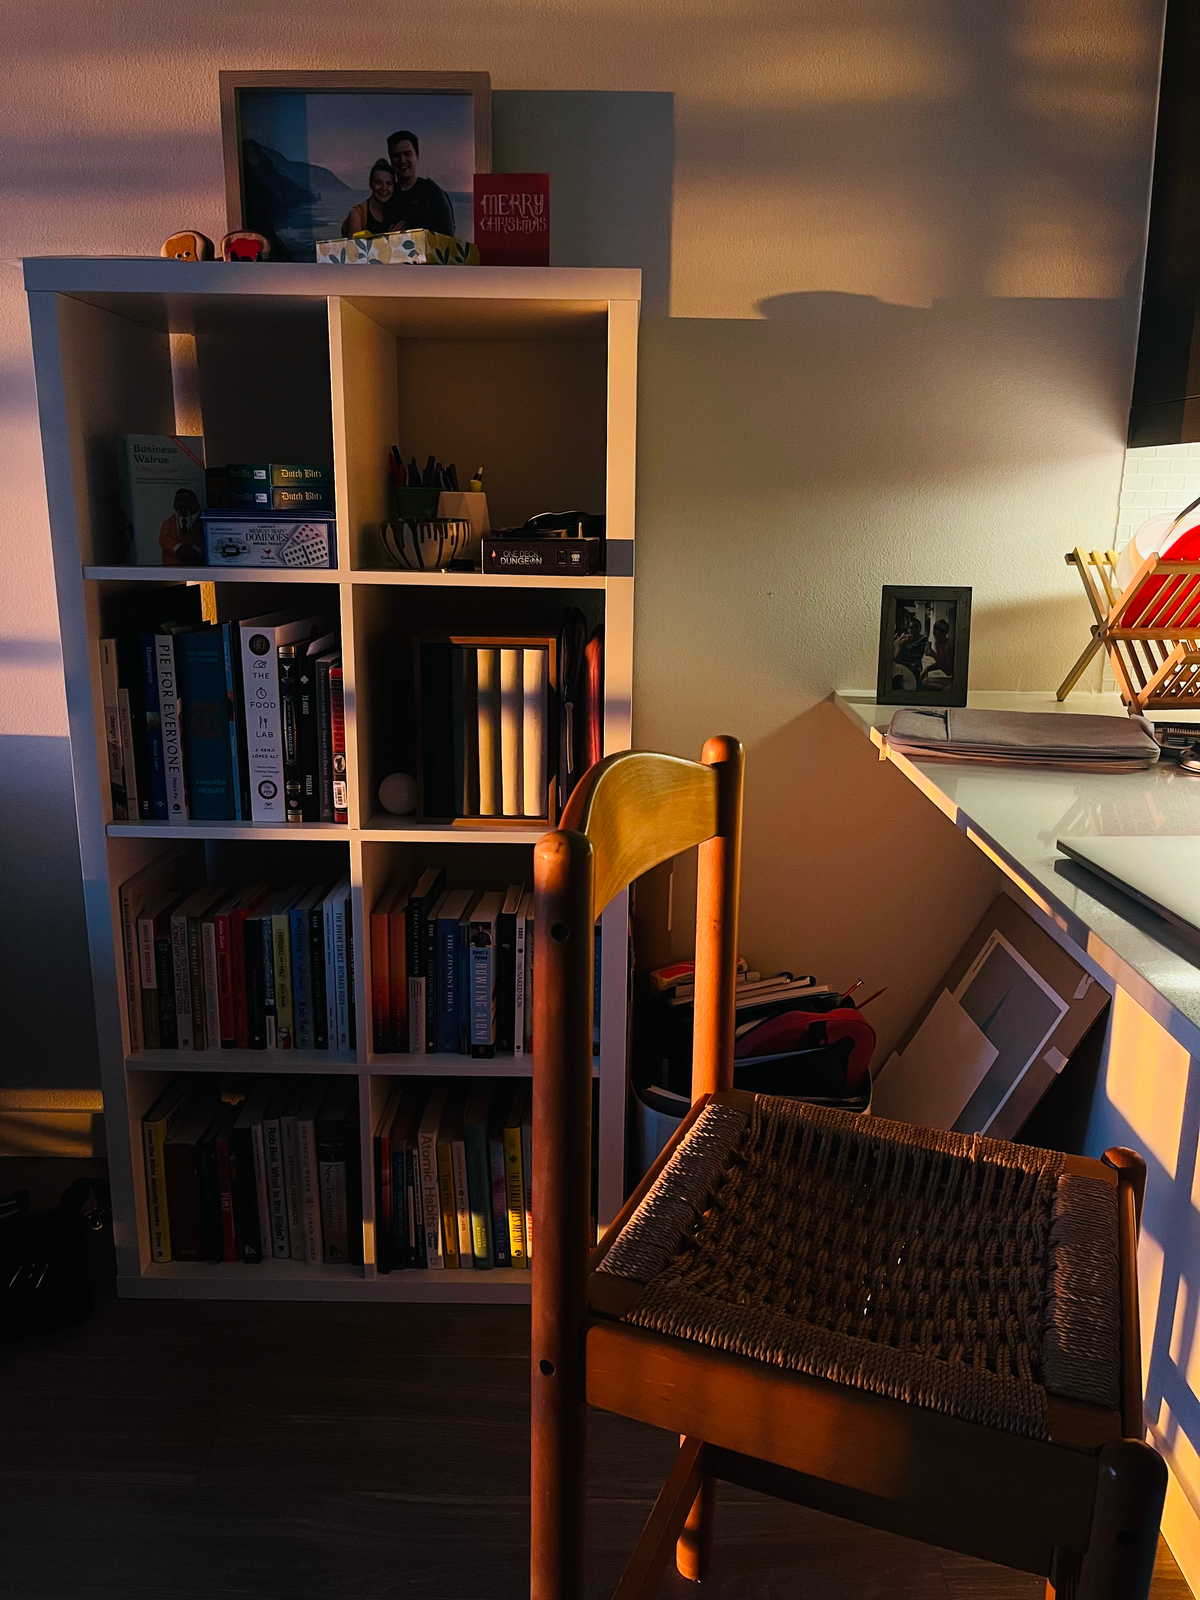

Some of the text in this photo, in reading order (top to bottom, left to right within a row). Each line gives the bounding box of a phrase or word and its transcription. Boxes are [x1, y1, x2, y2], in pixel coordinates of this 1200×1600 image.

[480, 193, 544, 219] MERRY
[133, 444, 177, 454] Business
[134, 454, 169, 464] Walrus
[280, 469, 322, 478] Dutch Blitz
[281, 491, 322, 501] Dutch Blitz
[245, 533, 289, 542] DOMINOES
[500, 557, 542, 566] DUNGEON
[503, 550, 540, 558] ONE DECK
[146, 646, 154, 684] Homespun
[159, 645, 180, 773] PIE FOR EVERYONE
[110, 716, 120, 770] design for good
[142, 925, 150, 944] DRIVEN
[172, 924, 181, 958] JONATHAN
[336, 924, 344, 943] DIVINE
[144, 951, 152, 983] DISTRACTION
[205, 956, 213, 985] GREATLY
[295, 963, 305, 991] Spiritual
[299, 1002, 307, 1018] Rob
[475, 963, 489, 1041] BOWLING ALONE
[299, 1020, 308, 1035] Bell
[268, 1127, 276, 1145] Rob
[269, 1147, 278, 1163] Bell
[271, 1166, 280, 1189] What
[421, 1135, 437, 1228] Atomic Habits
[442, 1173, 452, 1207] Tina Fey
[220, 1192, 230, 1212] PIMP
[273, 1200, 282, 1214] the
[325, 1185, 335, 1229] Testament
[509, 1171, 523, 1243] THE BIBLE TELLS ME SO
[275, 1215, 284, 1241] Bible?
